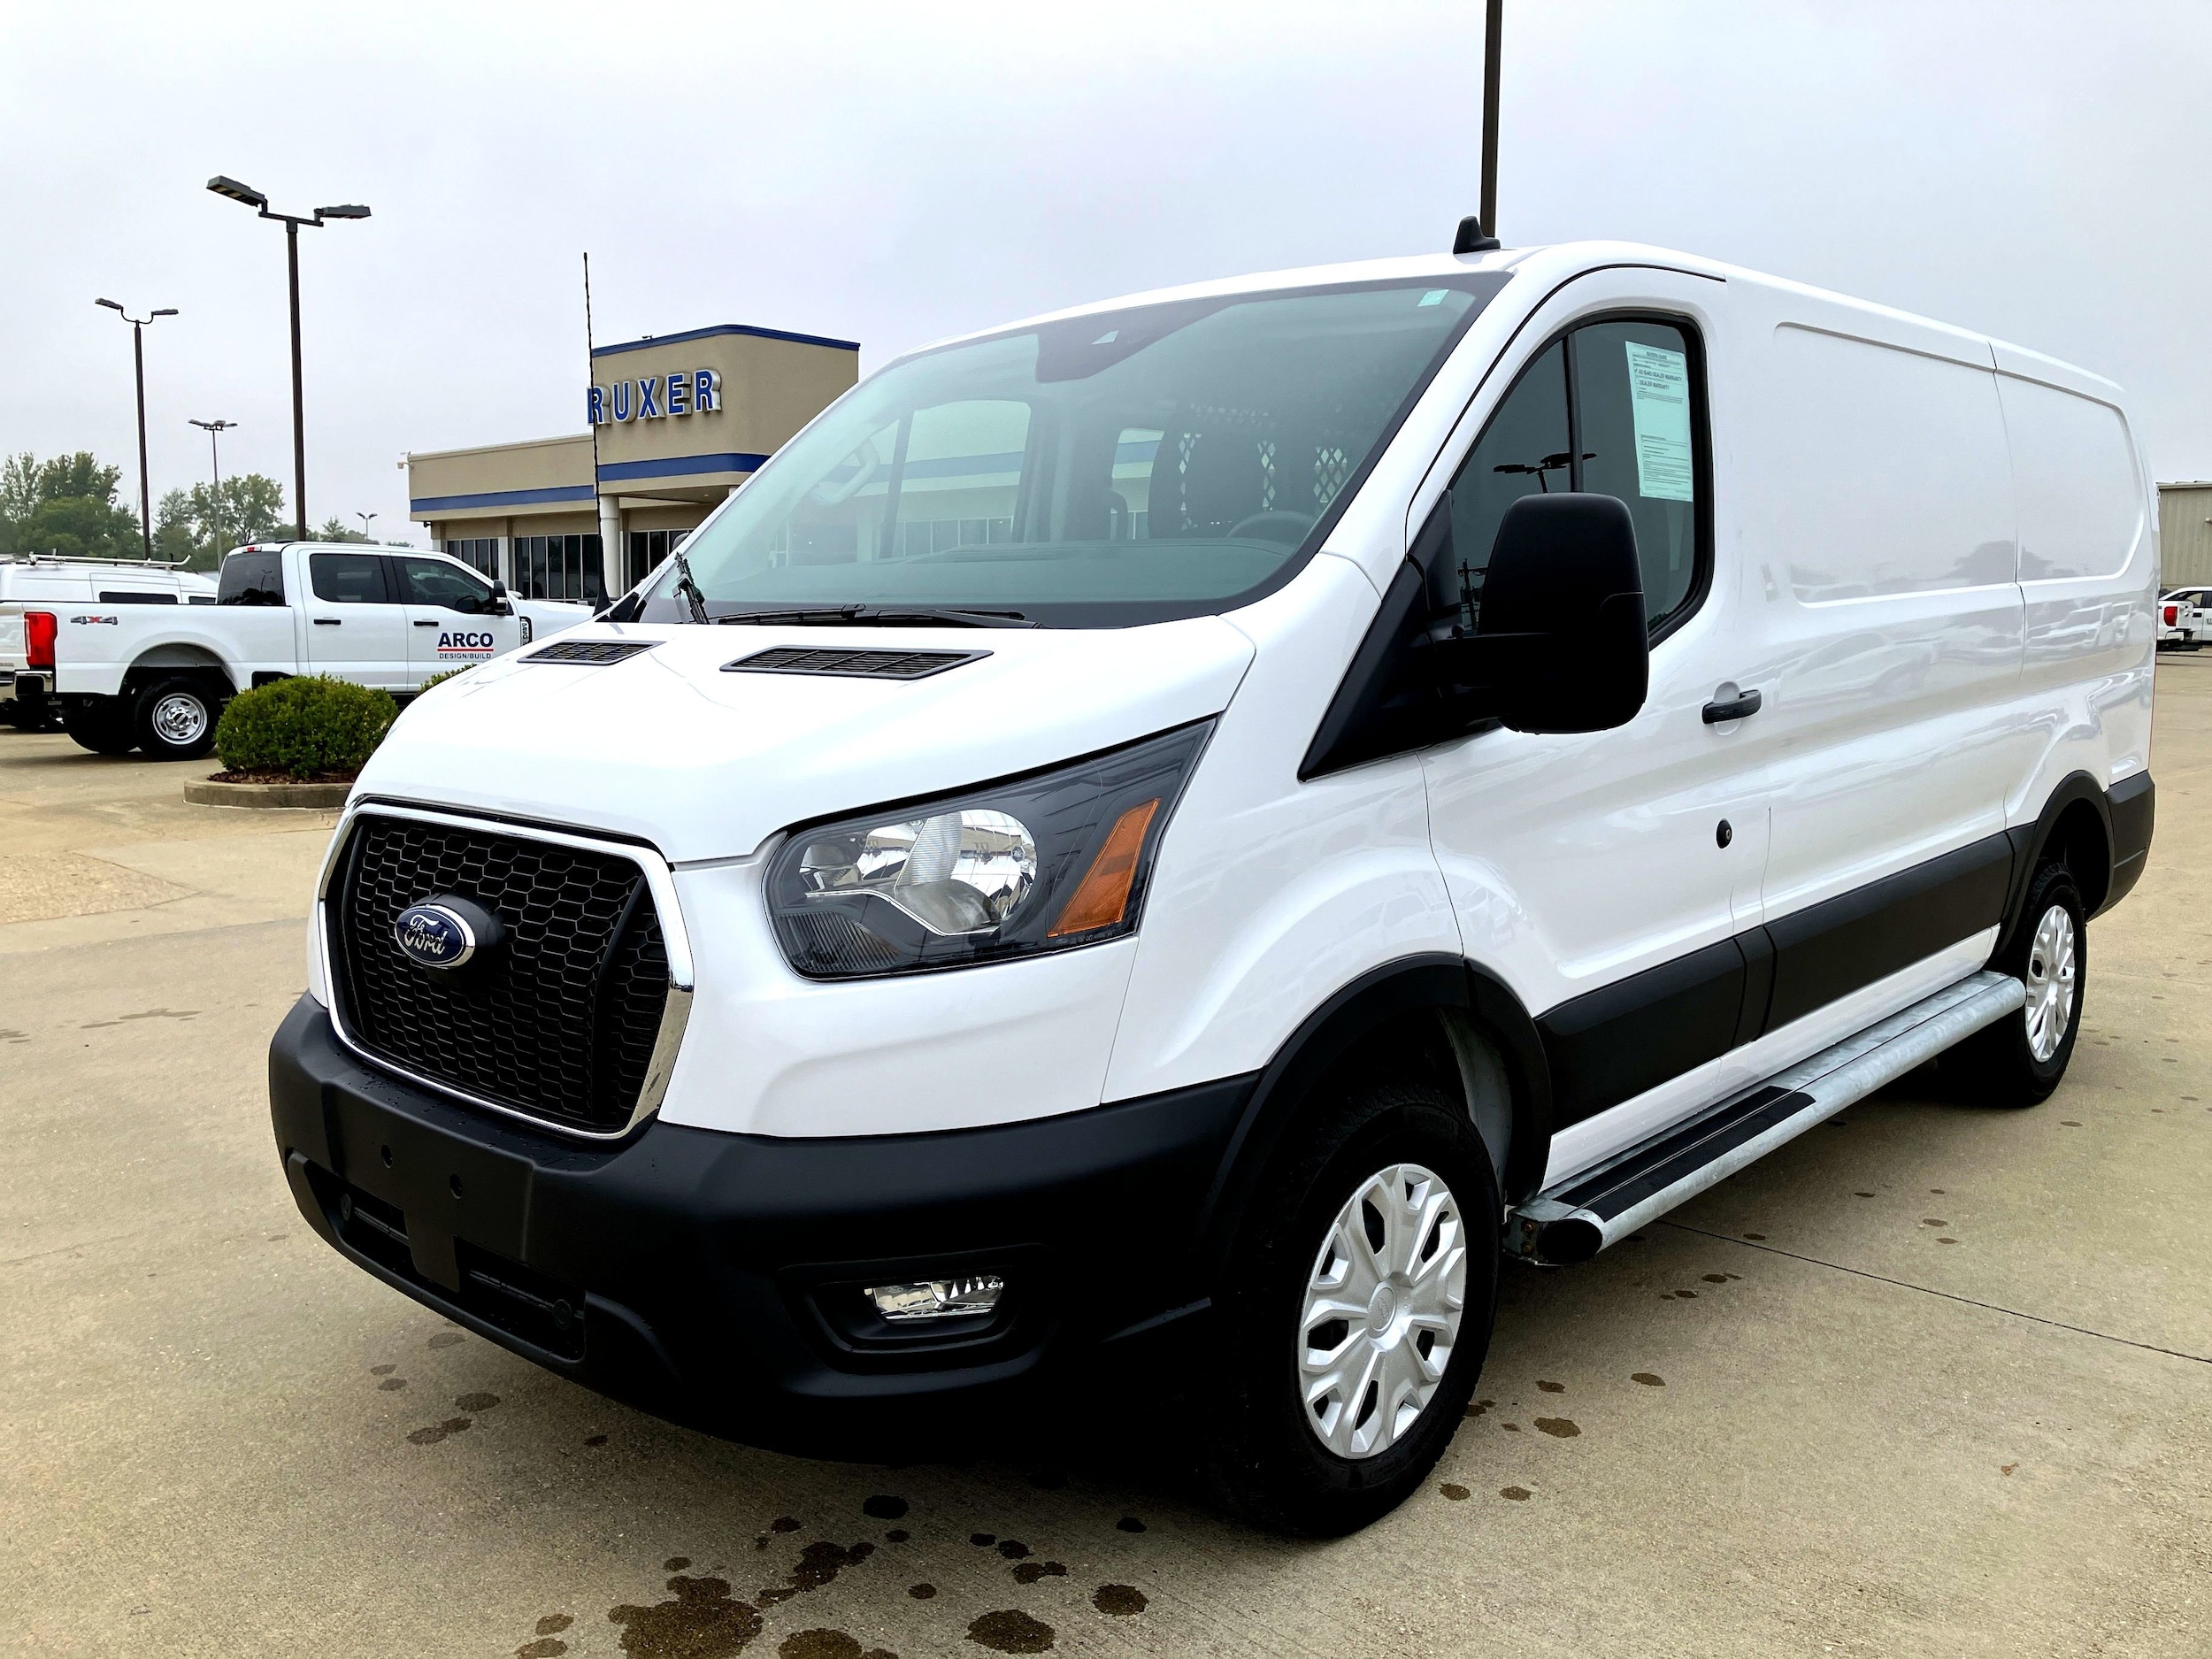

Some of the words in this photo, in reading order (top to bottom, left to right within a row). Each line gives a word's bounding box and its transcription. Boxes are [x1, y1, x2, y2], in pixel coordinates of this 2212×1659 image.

[587, 369, 722, 426] RUXER
[438, 633, 494, 648] ARCO
[403, 914, 449, 955] Ford
